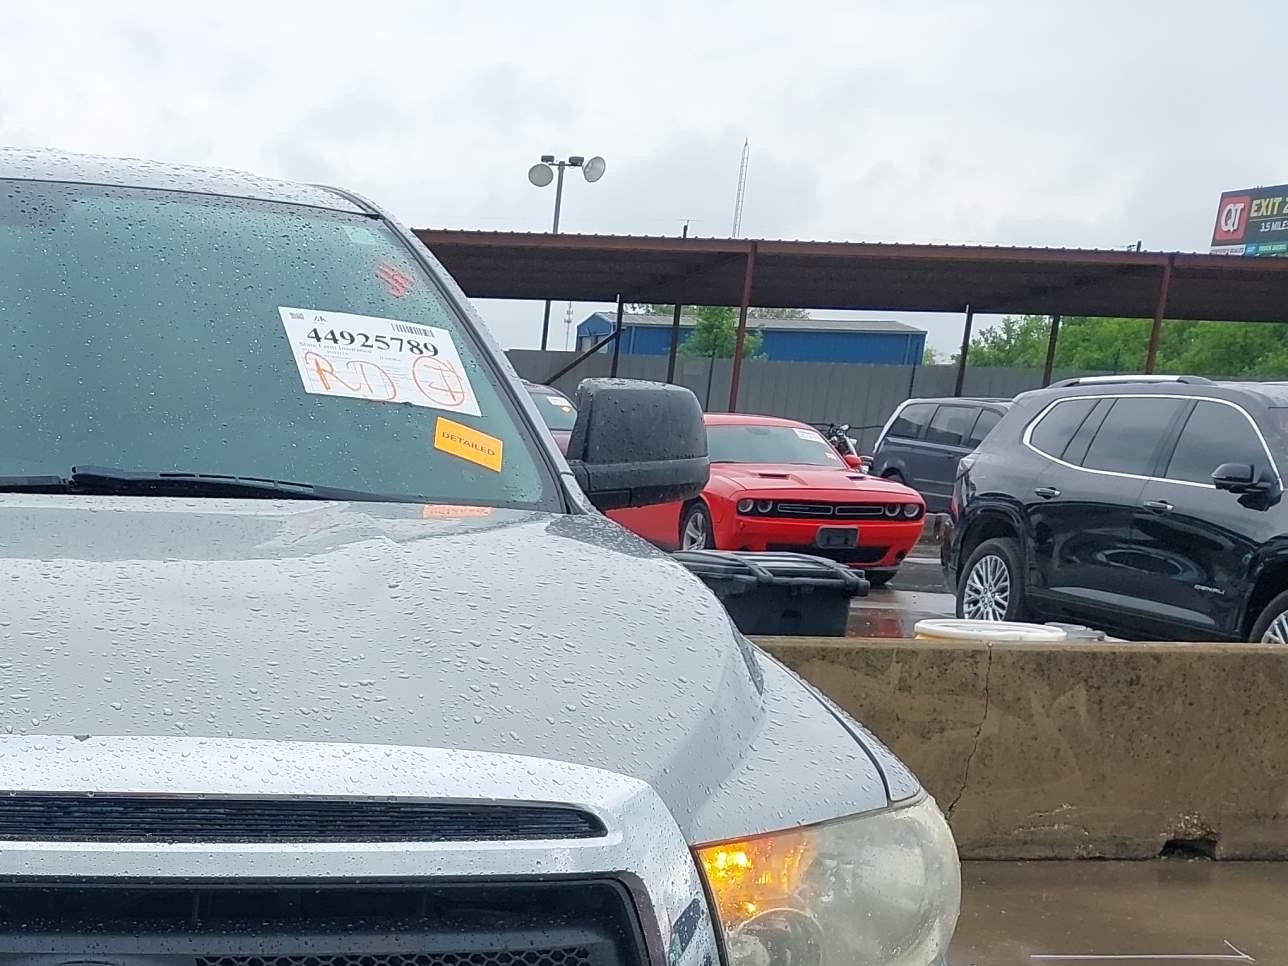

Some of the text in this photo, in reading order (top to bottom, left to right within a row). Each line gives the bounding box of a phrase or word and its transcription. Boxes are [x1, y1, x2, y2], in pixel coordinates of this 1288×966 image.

[1220, 203, 1245, 232] QT
[1250, 197, 1283, 217] EXIT
[306, 327, 439, 357] 44925789
[441, 431, 496, 456] DETAILED
